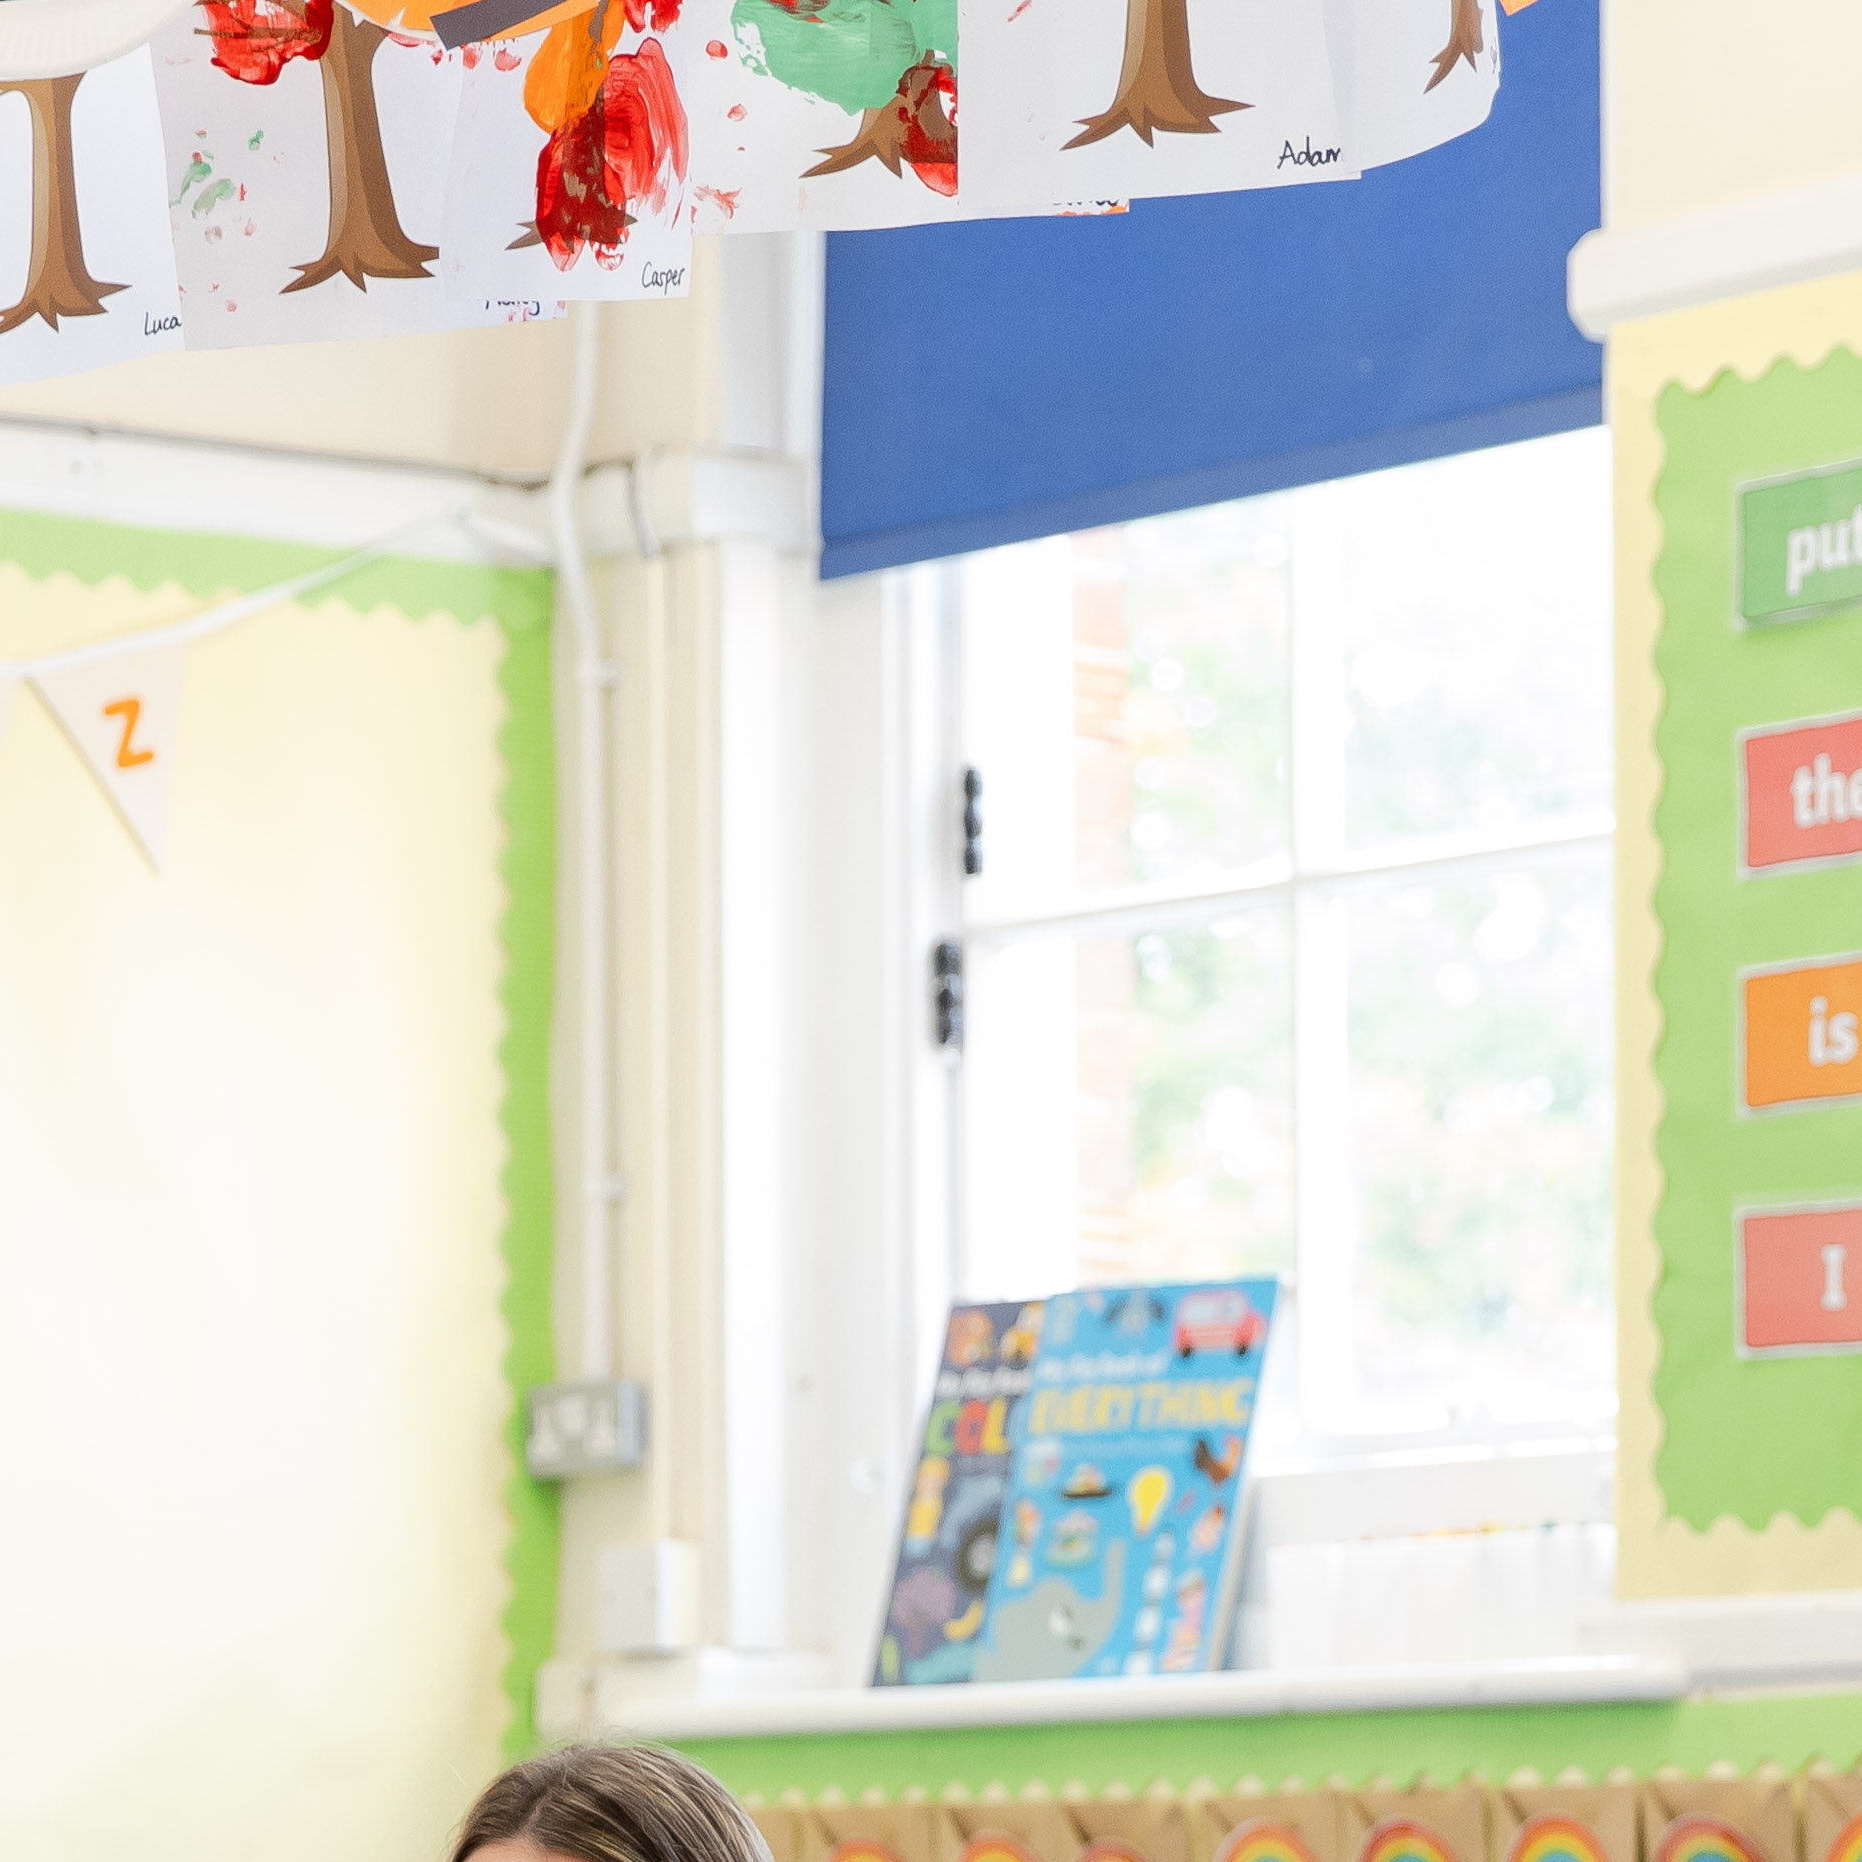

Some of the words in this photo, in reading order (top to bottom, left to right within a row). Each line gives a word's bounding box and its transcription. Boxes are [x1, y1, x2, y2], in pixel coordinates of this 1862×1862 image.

[641, 261, 685, 295] Casper
[143, 311, 183, 336] Luca
[103, 698, 154, 769] z
[1808, 996, 1859, 1067] is
[1820, 1243, 1848, 1311] I
